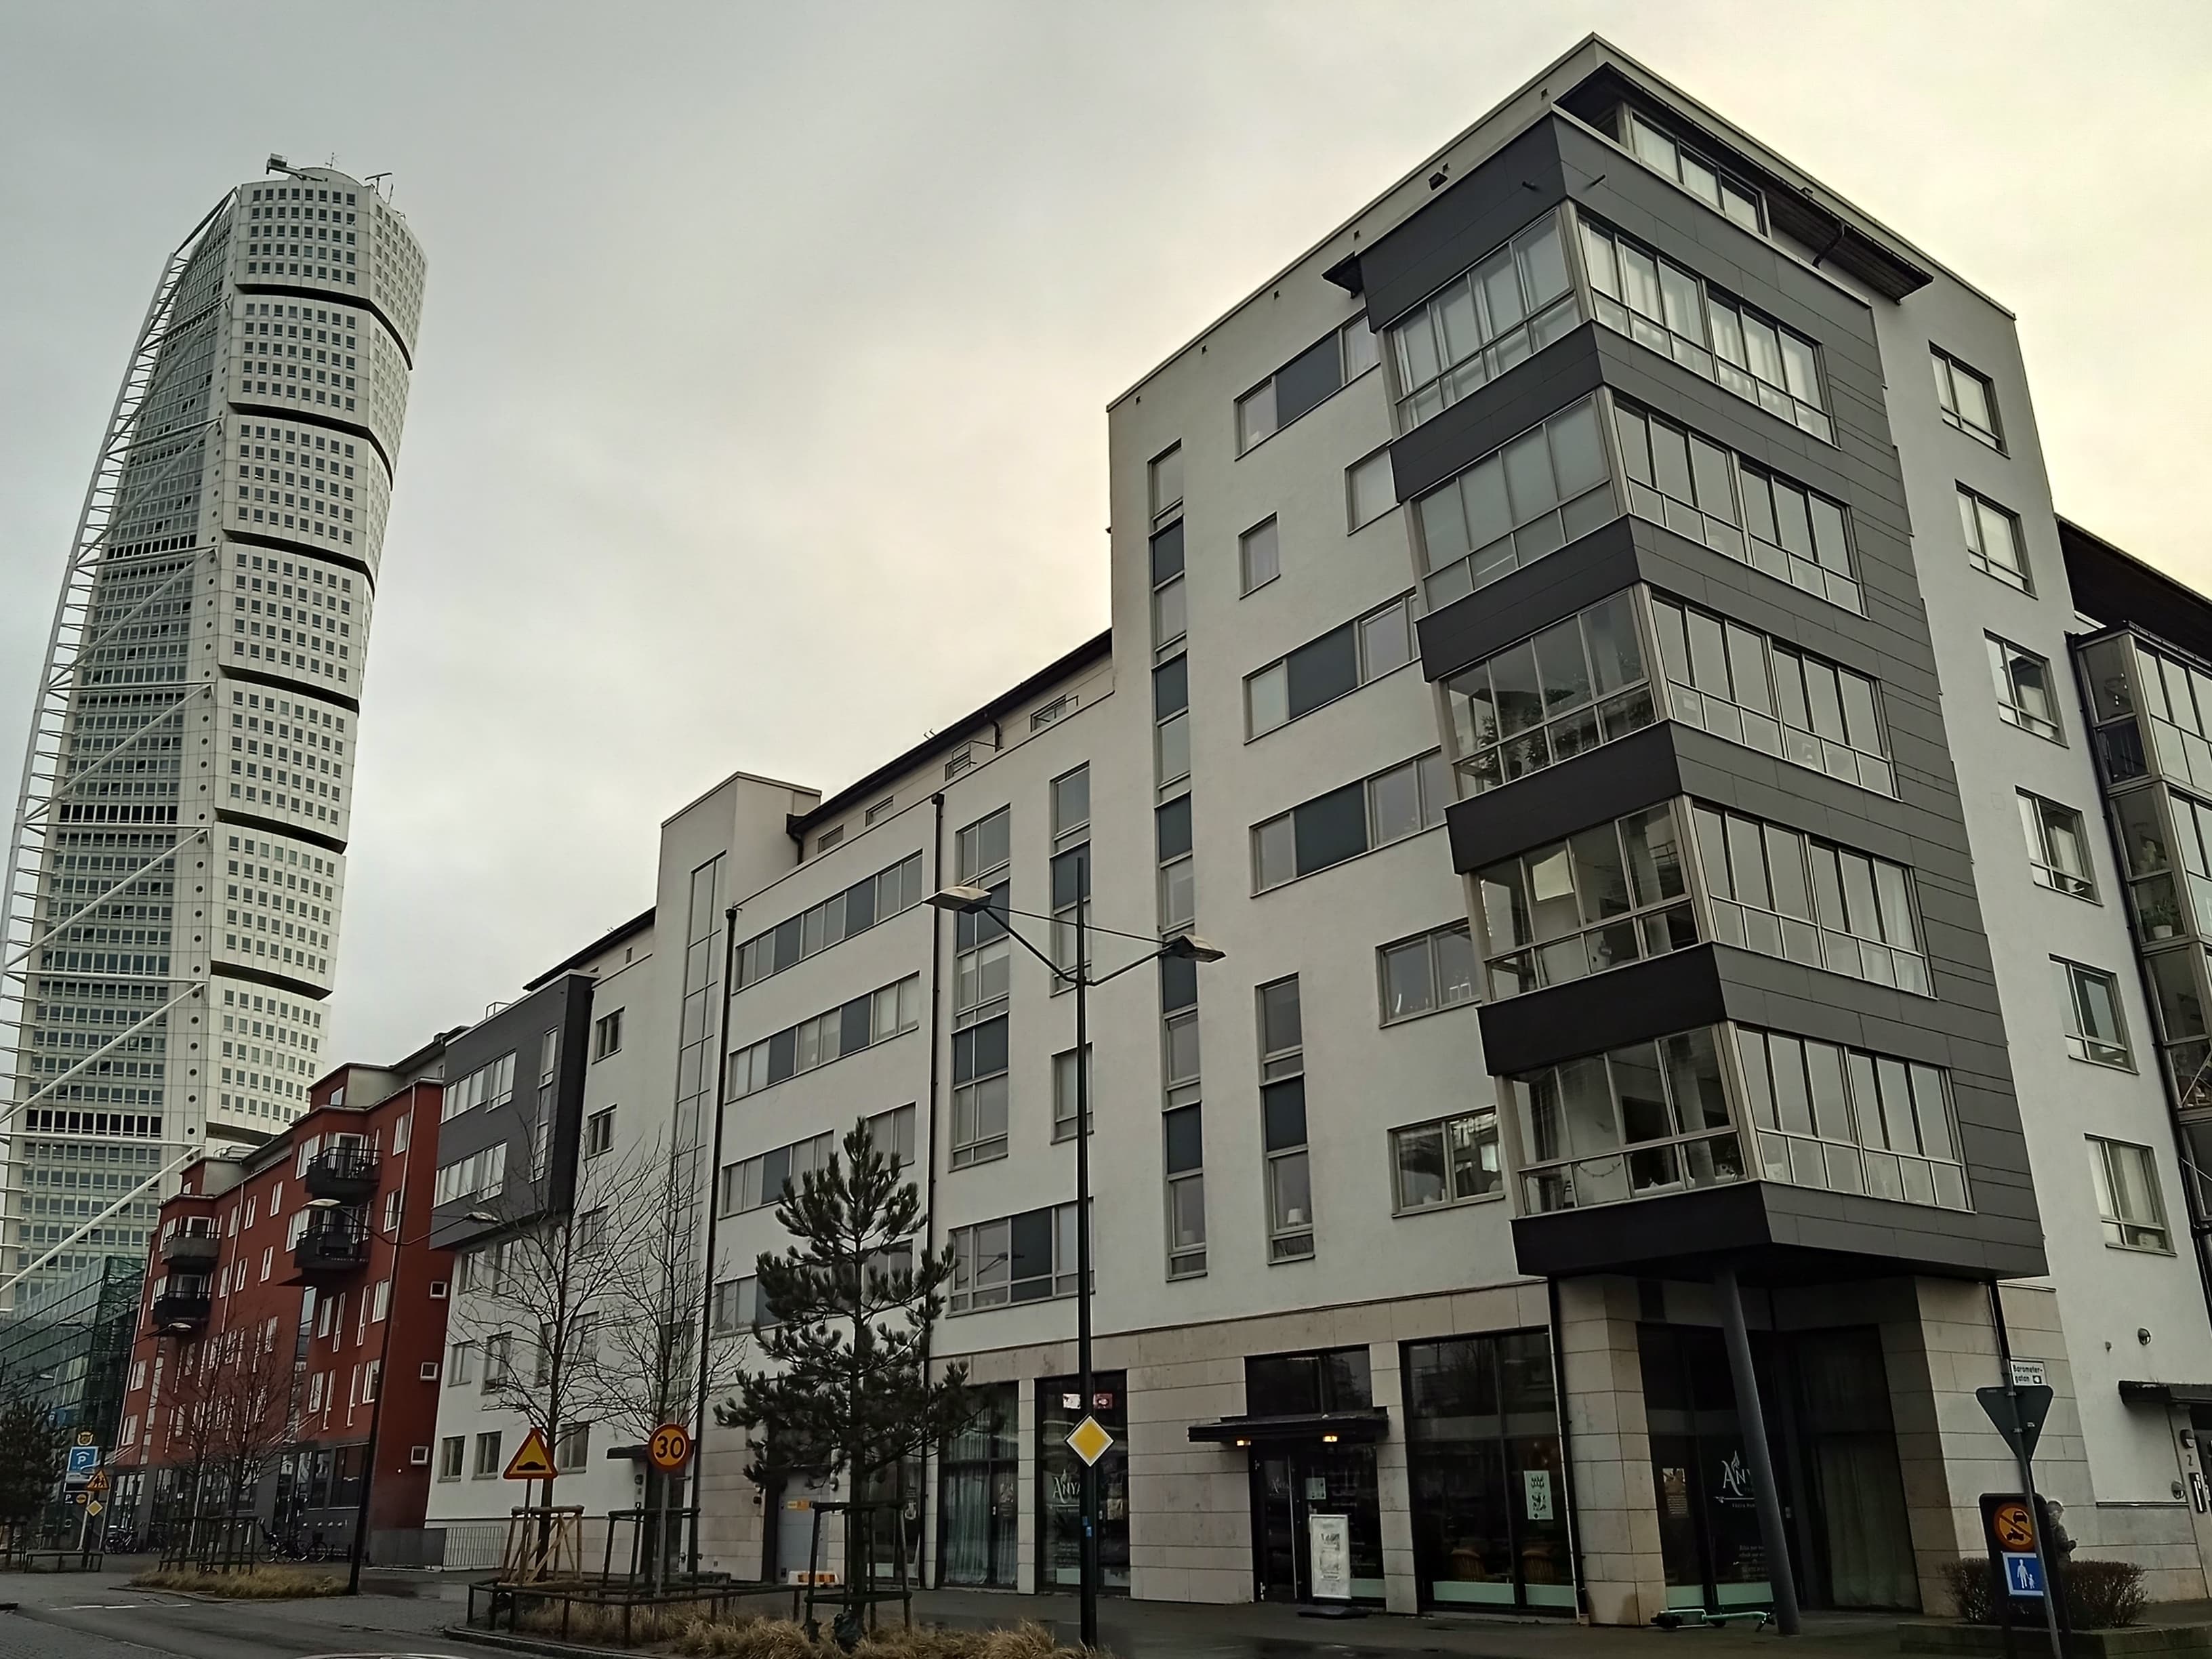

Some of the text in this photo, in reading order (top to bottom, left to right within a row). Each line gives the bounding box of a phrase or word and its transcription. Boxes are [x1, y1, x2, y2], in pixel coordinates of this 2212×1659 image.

[655, 1435, 685, 1459] 30
[77, 1455, 87, 1465] P
[2186, 1454, 2194, 1467] 2
[65, 1493, 72, 1501] P
